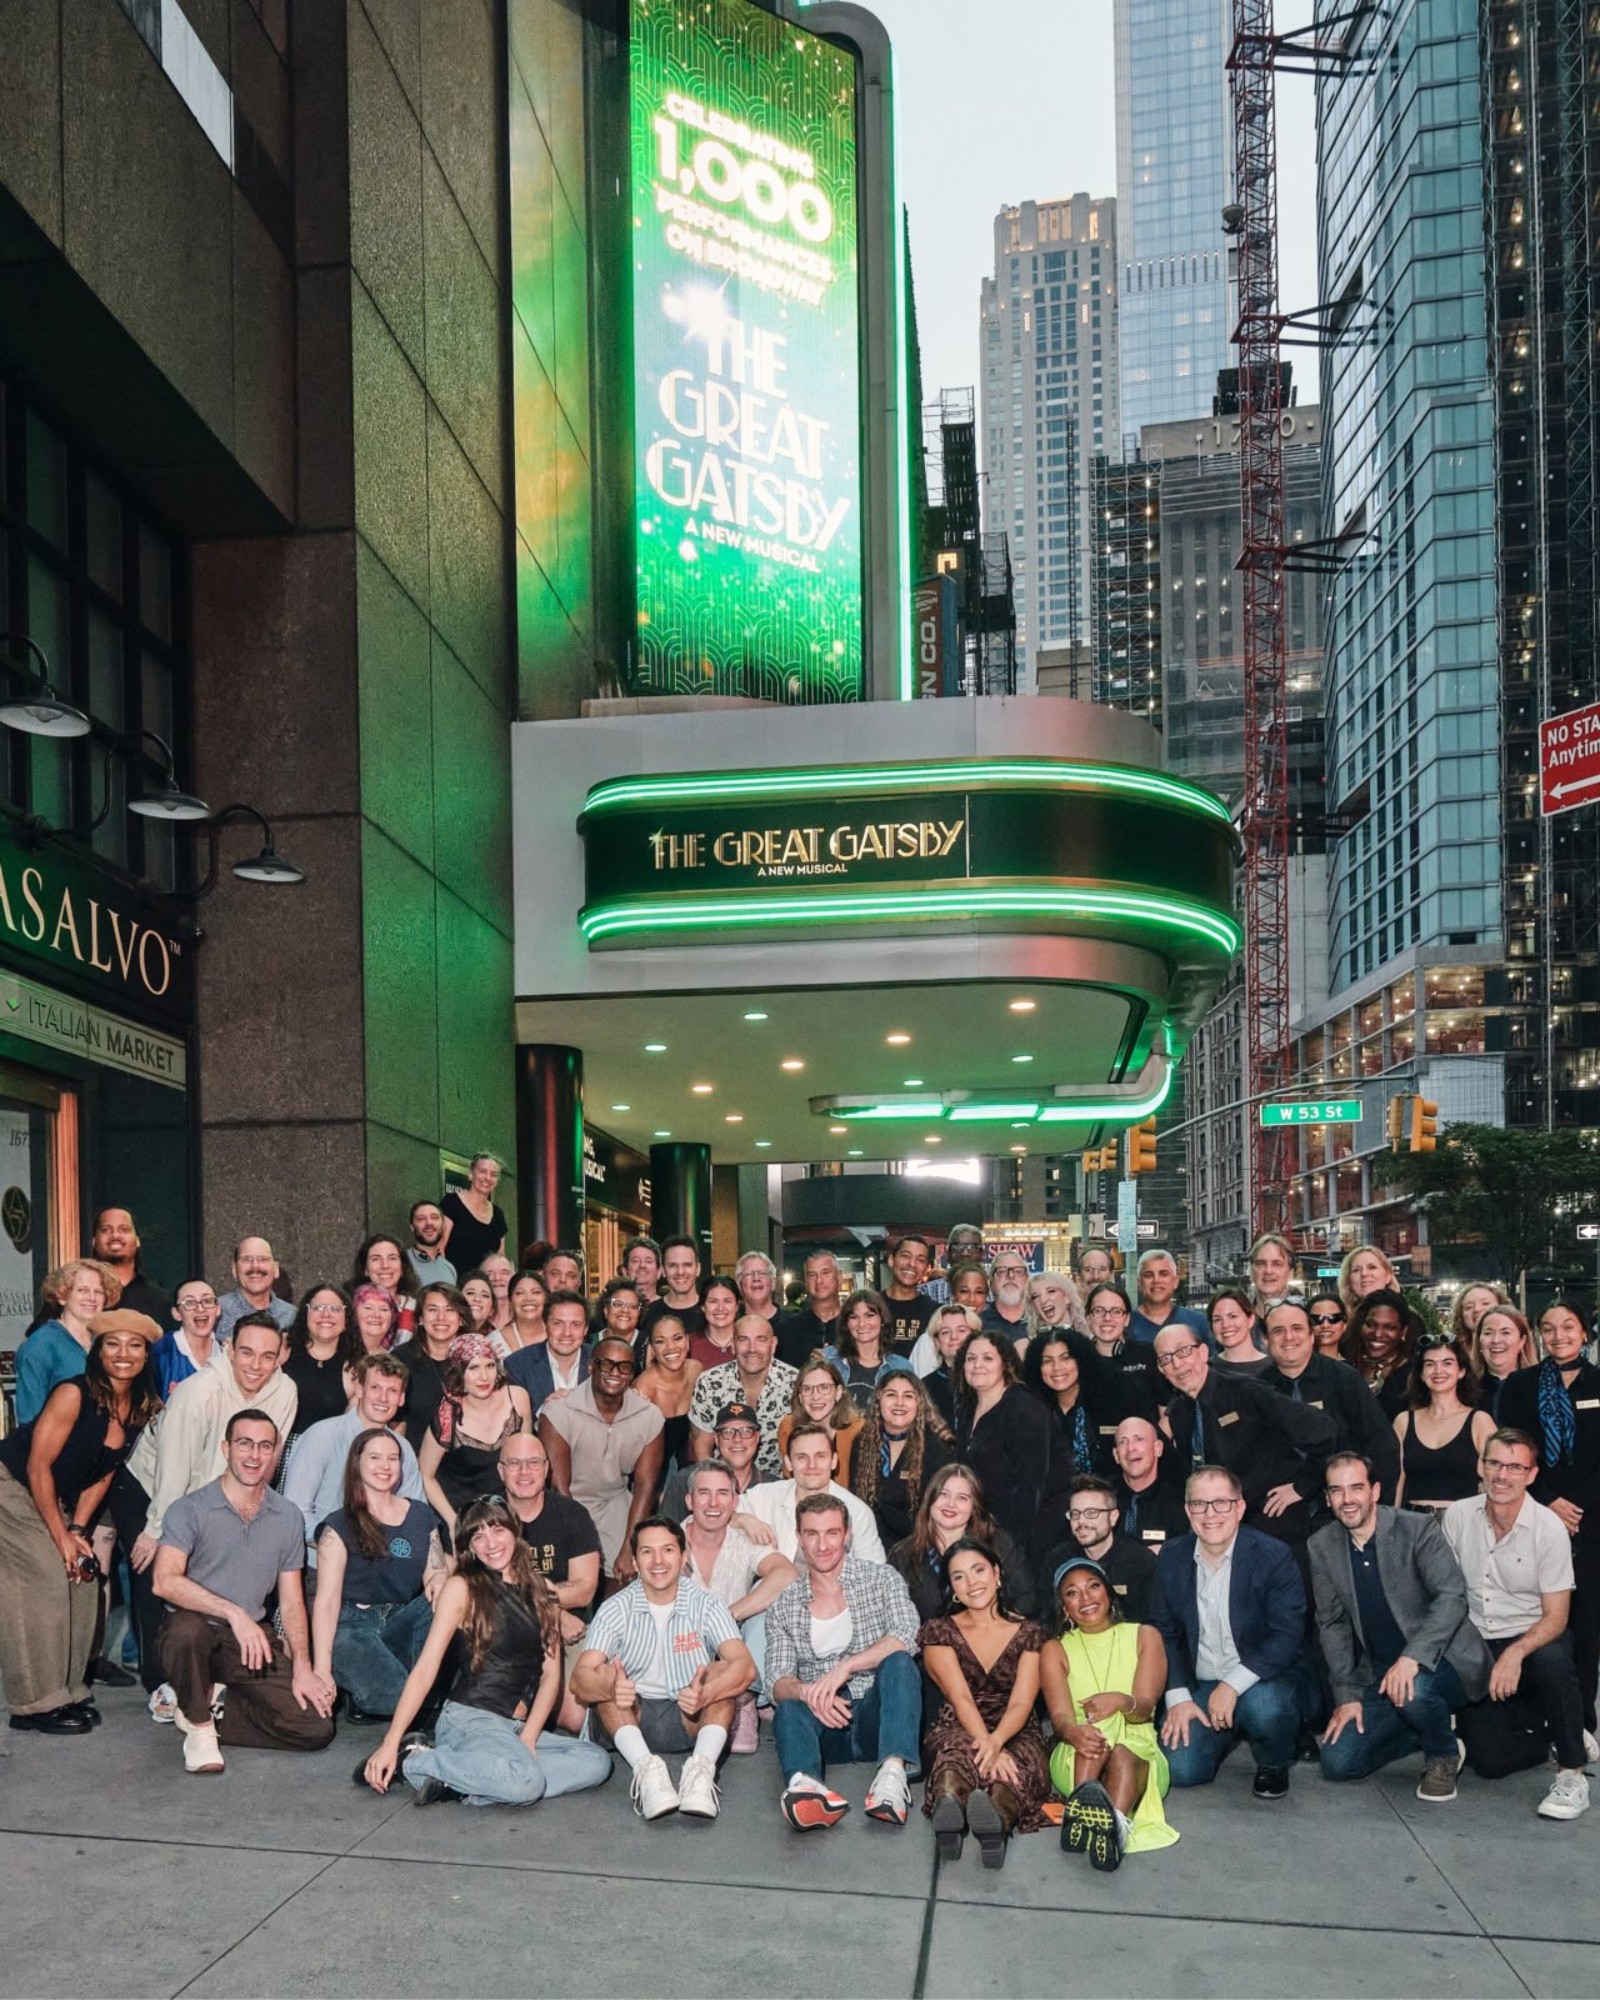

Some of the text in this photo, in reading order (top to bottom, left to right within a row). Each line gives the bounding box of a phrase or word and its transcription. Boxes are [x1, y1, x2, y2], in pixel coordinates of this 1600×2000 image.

[666, 93, 815, 178] CELEBRATING
[654, 115, 832, 243] 1,000
[697, 316, 787, 399] THE
[658, 369, 829, 481] GREAT
[646, 438, 850, 551] GATSBY
[684, 517, 821, 574] A NEW MUSICAL
[920, 615, 937, 665] CO.
[1547, 725, 1569, 748] NO
[648, 819, 965, 870] THE GREAT GATSBY
[757, 863, 849, 878] A NEW MUSICAL
[28, 995, 175, 1074] ITALIAN MARKET
[1279, 1105, 1343, 1121] W 53 St
